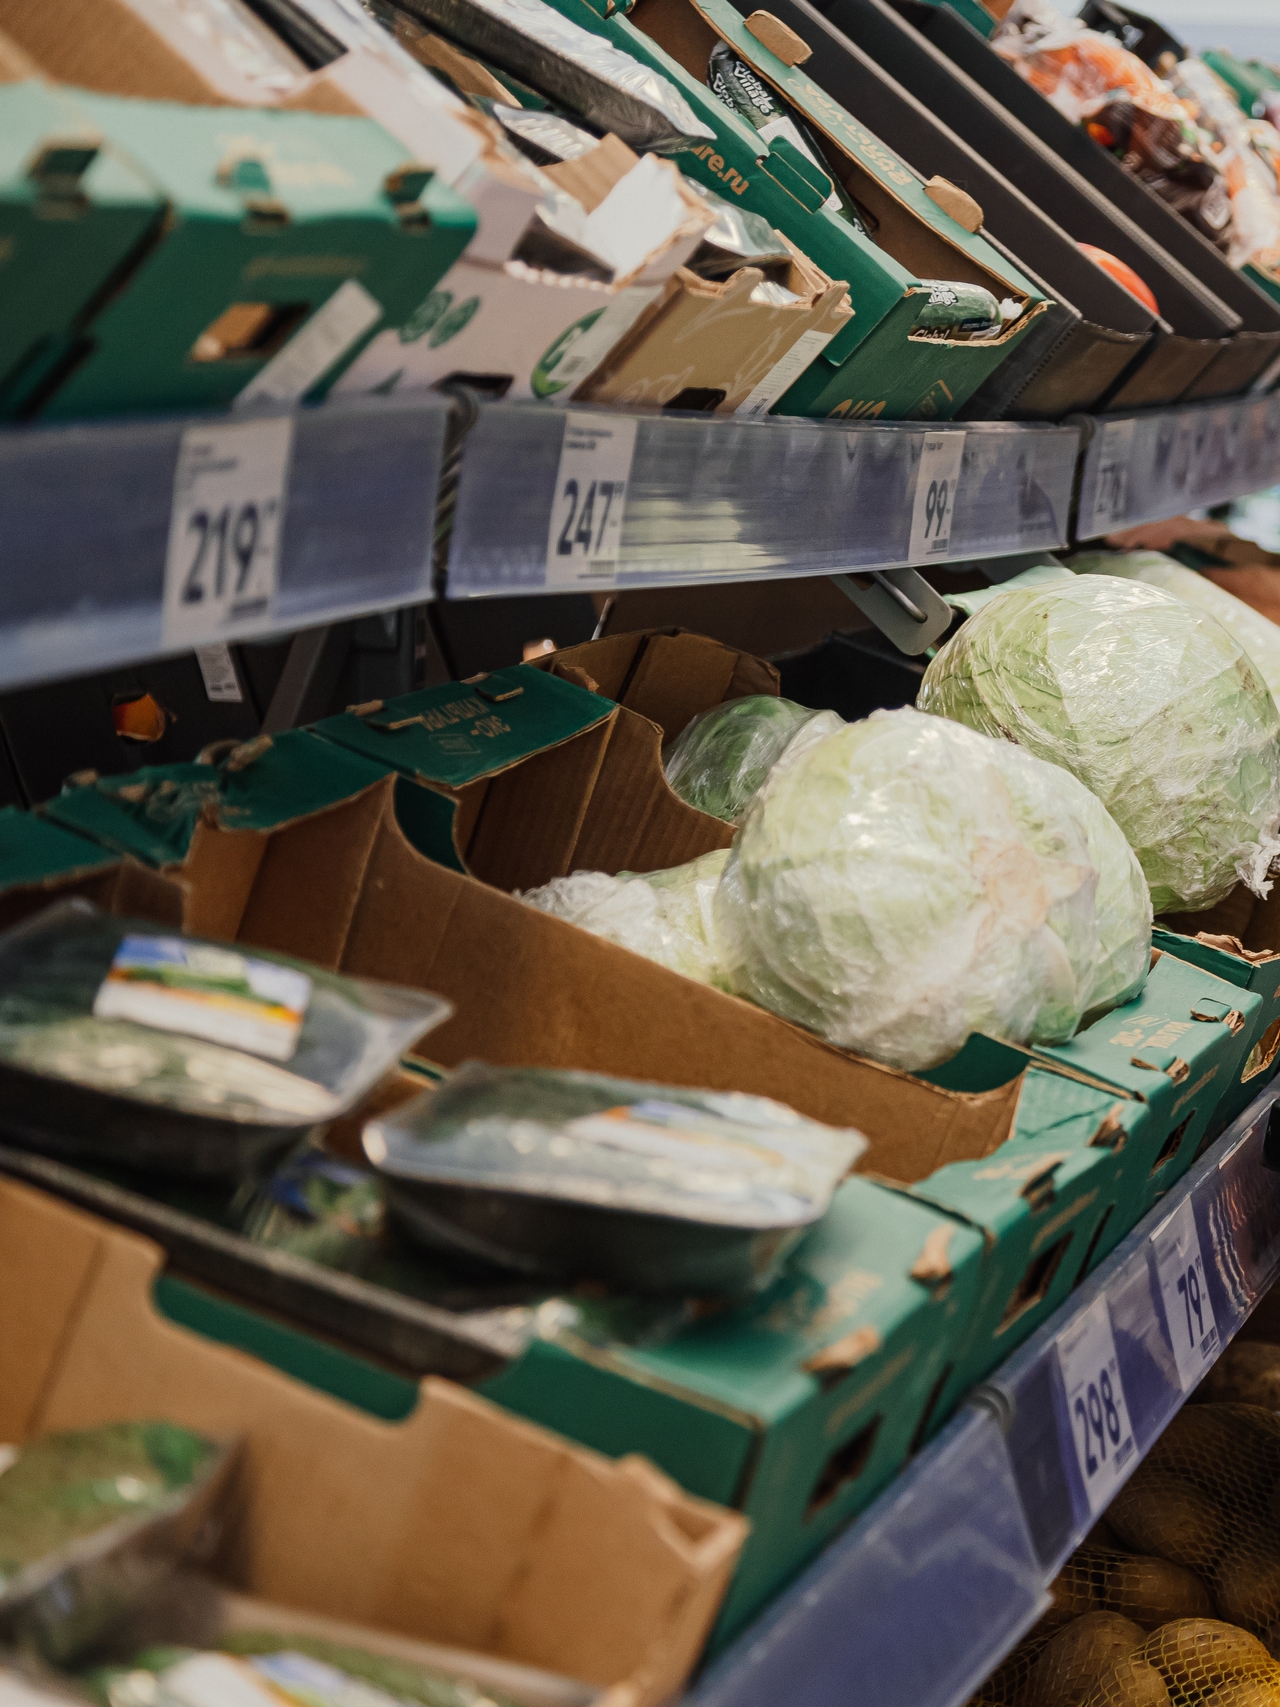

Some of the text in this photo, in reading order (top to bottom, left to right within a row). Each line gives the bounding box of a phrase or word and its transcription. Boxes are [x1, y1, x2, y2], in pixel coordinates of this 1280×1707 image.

[556, 478, 615, 555] 247
[924, 480, 949, 538] 99
[182, 502, 258, 605] 219
[1177, 1264, 1204, 1349] 79
[1074, 1368, 1120, 1479] 298
